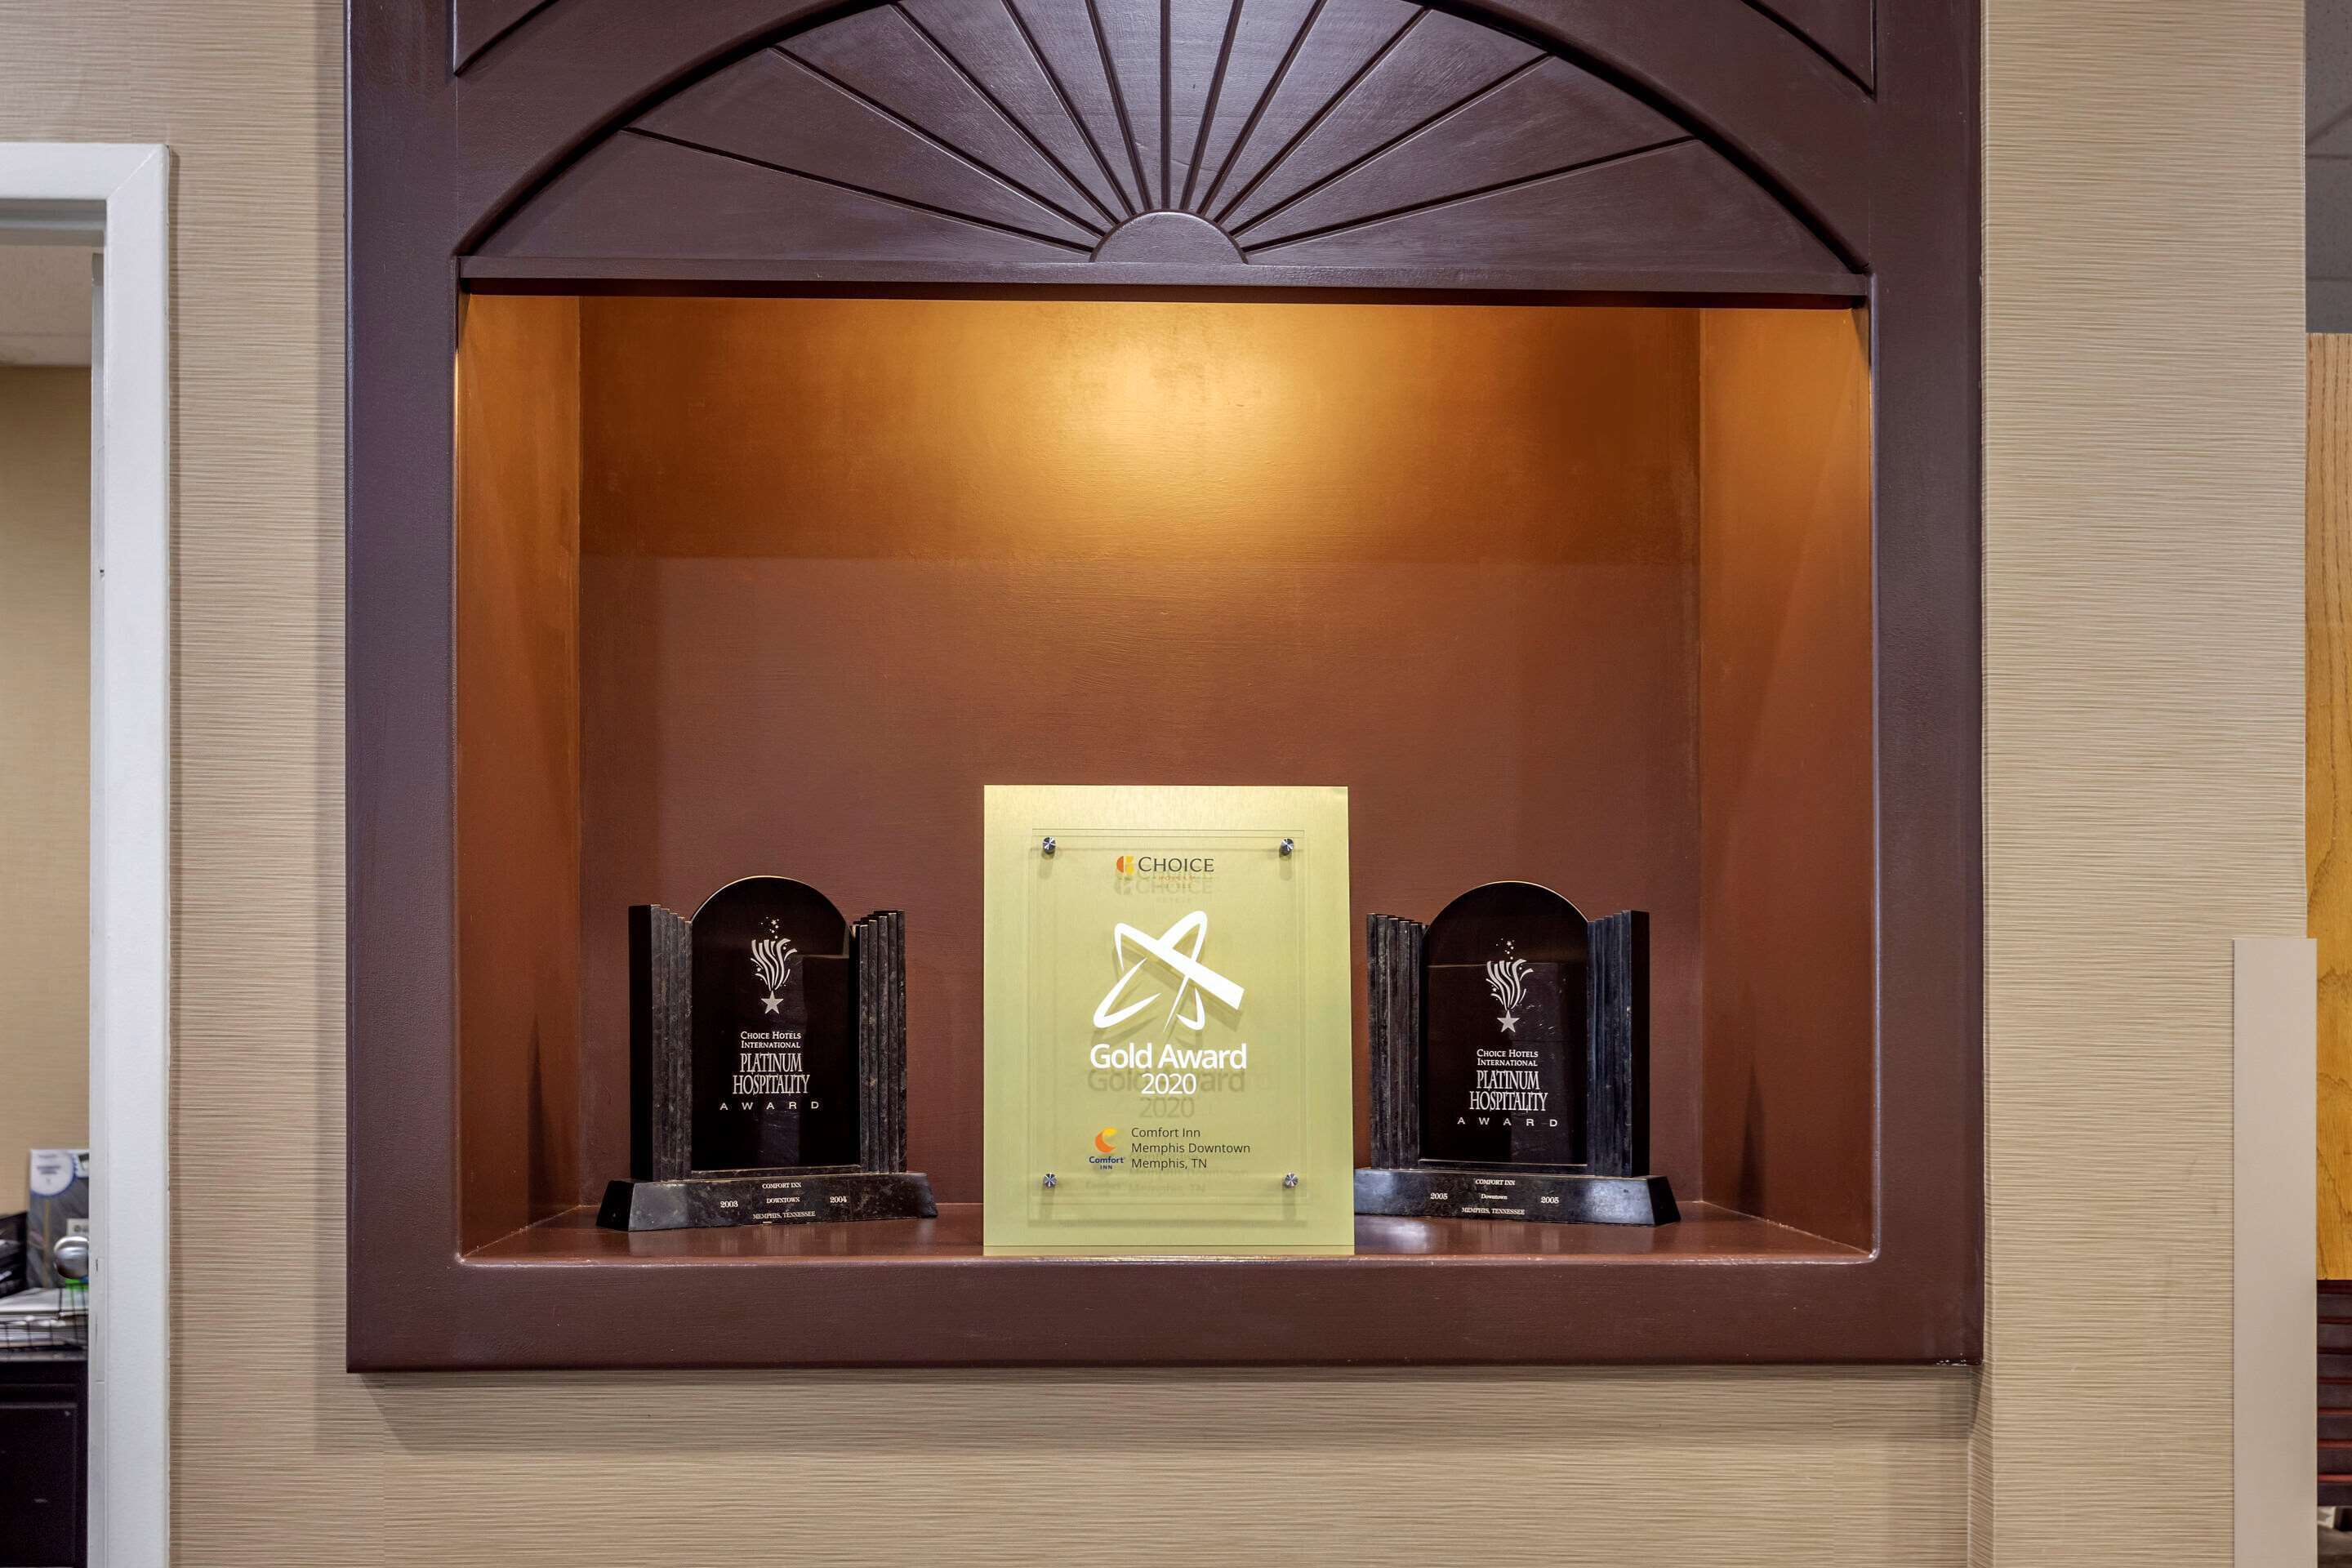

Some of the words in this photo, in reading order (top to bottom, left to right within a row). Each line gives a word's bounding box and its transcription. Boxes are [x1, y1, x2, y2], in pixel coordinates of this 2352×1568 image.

[1138, 857, 1214, 872] CHOICE
[740, 1031, 770, 1040] CHOICE
[772, 1031, 802, 1040] HOTELS
[741, 1040, 801, 1049] INTERNATIONAL
[1090, 1042, 1152, 1069] Gold
[1157, 1043, 1247, 1069] Award
[1477, 1049, 1506, 1058] CHOICE
[1508, 1049, 1539, 1058] HOTELS
[739, 1053, 803, 1074] PLATINUM
[1477, 1058, 1538, 1067] INTERNATIONAL
[732, 1074, 810, 1095] HOSPITALITY
[1141, 1072, 1197, 1094] 2020
[1476, 1070, 1540, 1090] PLATINUM
[719, 1101, 819, 1111] AWARD
[1469, 1090, 1548, 1111] HOSPITALITY
[1457, 1116, 1558, 1127] AWARD
[1131, 1127, 1179, 1138] Comfort
[1183, 1127, 1200, 1138] Inn
[1131, 1143, 1185, 1155] Memphis
[1188, 1143, 1250, 1153] Downtown
[1089, 1156, 1124, 1164] Comfort
[1131, 1158, 1188, 1170] Memphis,
[1192, 1158, 1207, 1169] TN
[830, 1196, 847, 1204] 2004
[1430, 1192, 1448, 1200] 2005
[783, 1210, 816, 1218] TENNESSEE
